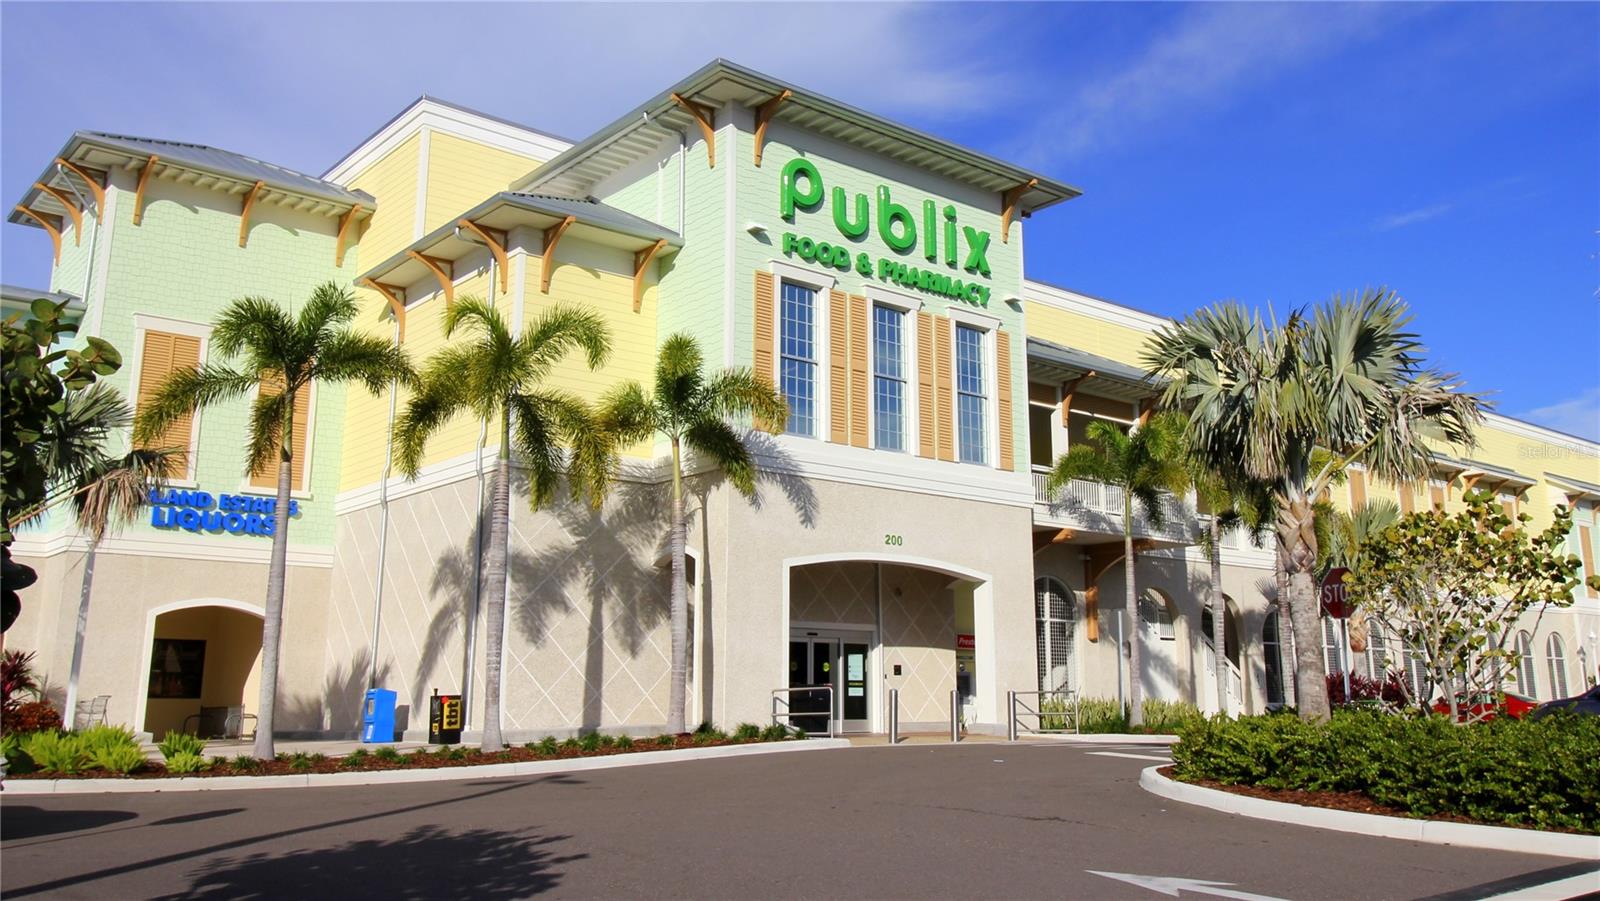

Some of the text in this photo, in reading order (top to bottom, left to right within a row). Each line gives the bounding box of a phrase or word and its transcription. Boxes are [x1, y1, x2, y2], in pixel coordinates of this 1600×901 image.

[780, 158, 992, 275] Publix
[782, 231, 992, 306] FOOD & PHARMACY
[149, 488, 299, 516] LAND ESTATS
[151, 506, 277, 535] LIQUORS
[884, 534, 903, 546] 200
[1324, 583, 1353, 604] STO
